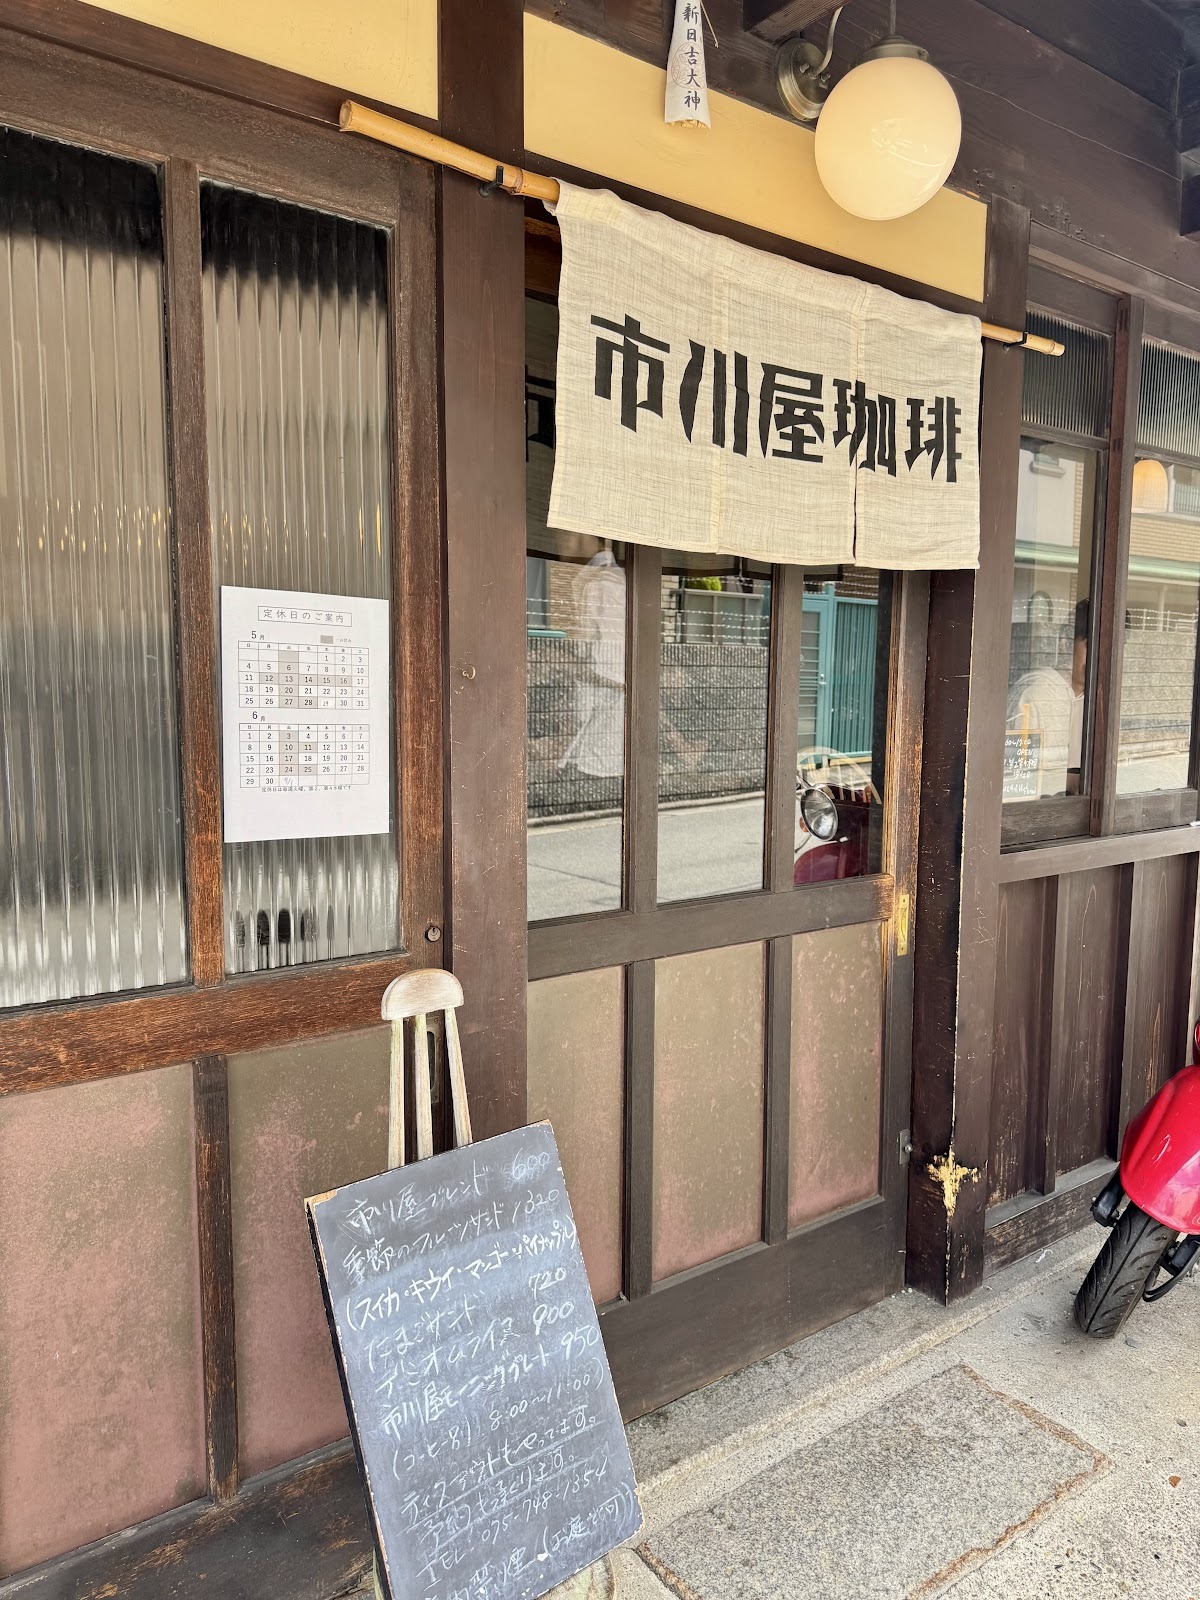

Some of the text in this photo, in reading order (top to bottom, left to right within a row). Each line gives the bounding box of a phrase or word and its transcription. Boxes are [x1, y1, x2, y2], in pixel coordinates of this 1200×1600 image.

[682, 3, 701, 111] 新日吉大神
[591, 313, 963, 483] 市川屋珈琲
[263, 608, 344, 623] 定休日のご案内
[245, 685, 254, 693] 18
[285, 675, 294, 683] 13
[340, 677, 348, 685] 16
[340, 699, 348, 707] 30
[265, 766, 274, 774] 23
[265, 777, 274, 785] 30
[340, 743, 348, 751] 13
[348, 1146, 550, 1235] 市川屋ブレンド 600
[343, 1189, 560, 1286] 季節のフルーツサンド 1320
[365, 1267, 567, 1373] たまごサンド 720
[375, 1301, 575, 1399] デミオムライス 900
[382, 1325, 601, 1440] 市川屋モーニングプレート 950
[481, 1457, 608, 1545] 075-748-1354
[425, 1548, 535, 1600] 内禁煙
